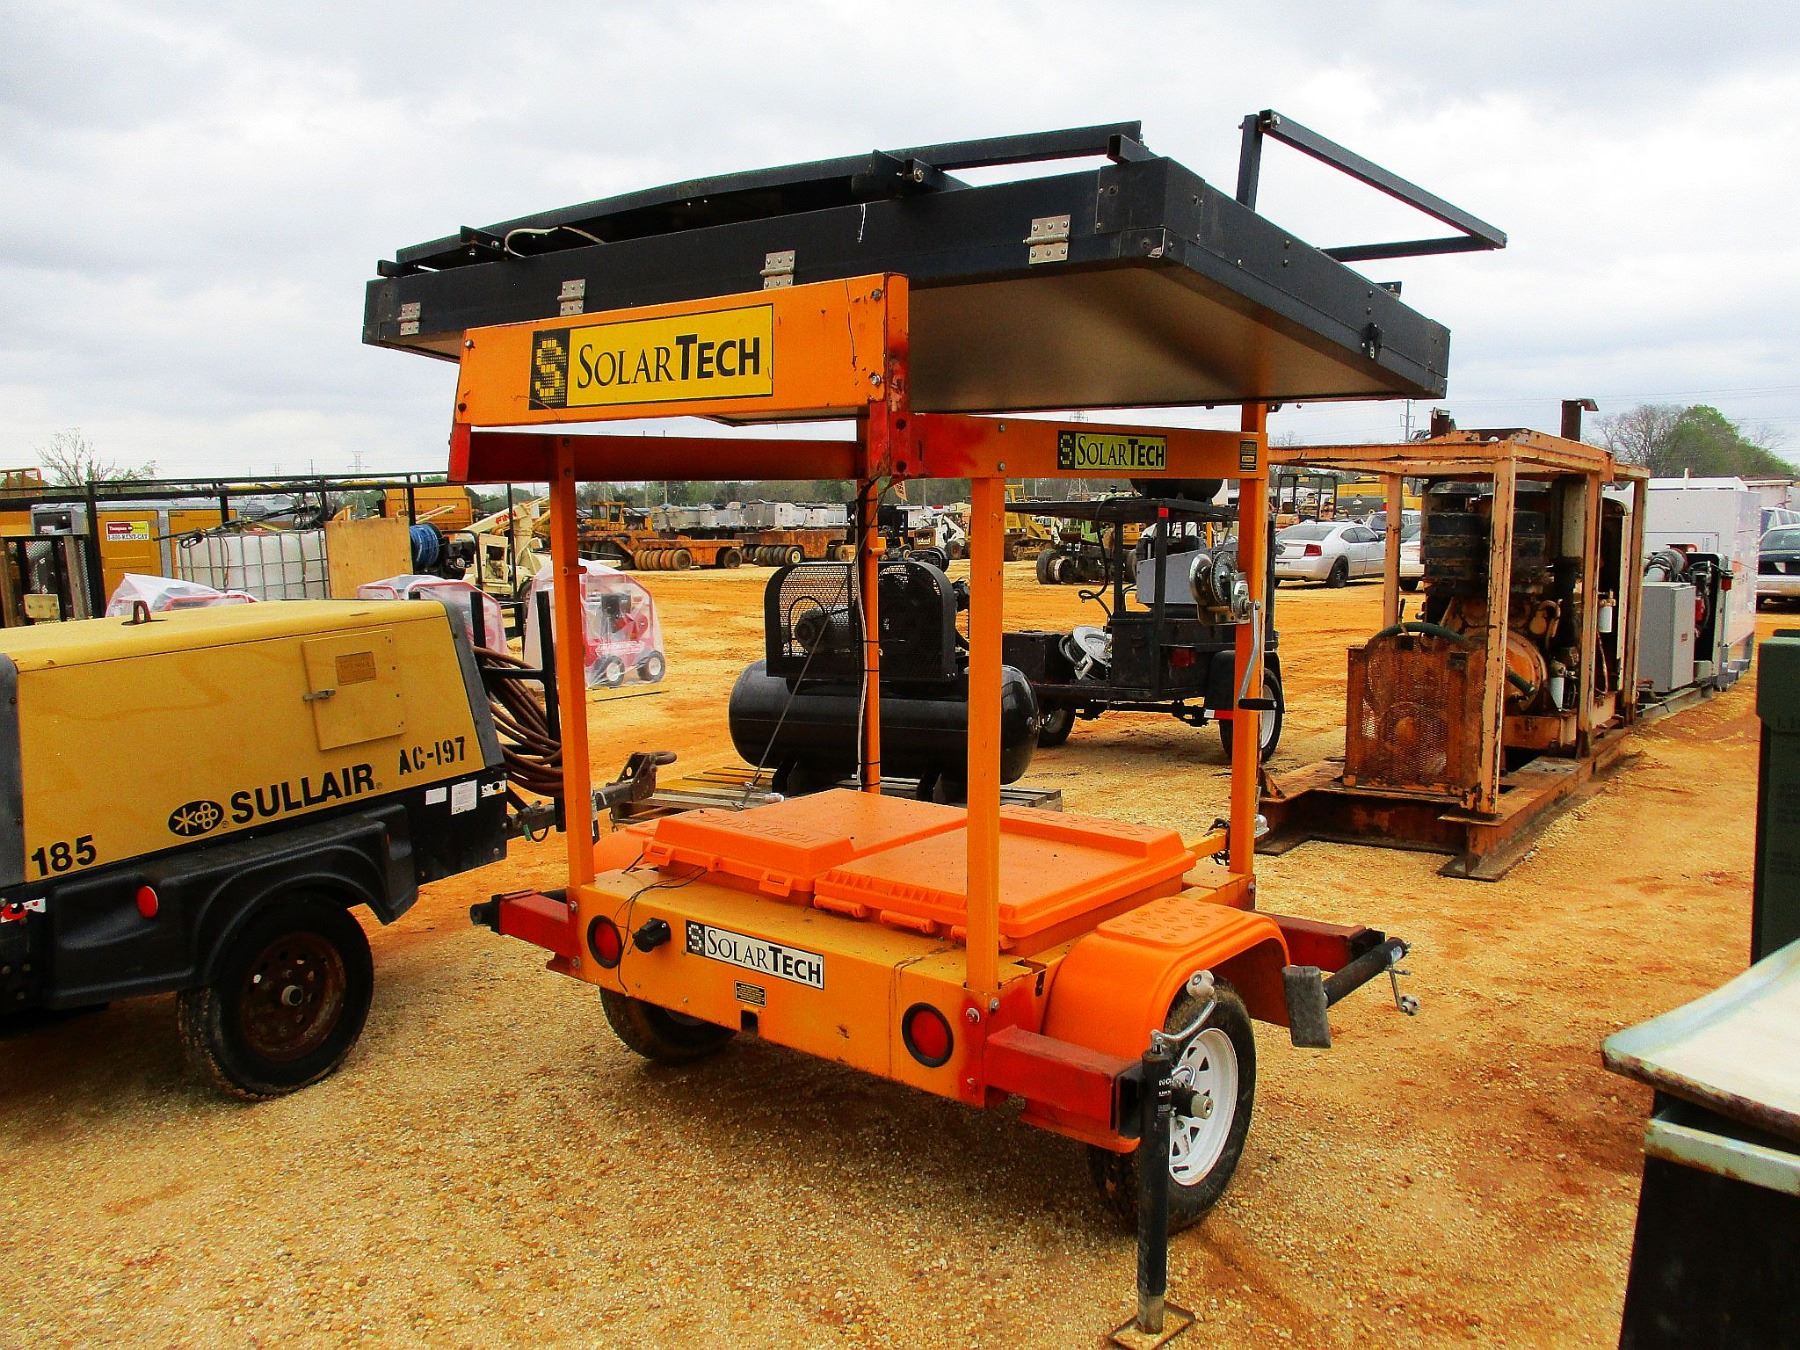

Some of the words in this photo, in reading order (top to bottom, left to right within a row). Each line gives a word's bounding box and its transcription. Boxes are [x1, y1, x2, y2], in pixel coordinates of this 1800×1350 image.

[578, 334, 760, 388] SOLARTECH
[1077, 436, 1164, 466] SOLARTECH
[399, 736, 466, 776] AC-197
[230, 763, 376, 824] SULLAIR
[31, 834, 97, 876] 185
[707, 930, 821, 984] SOLARTECH
